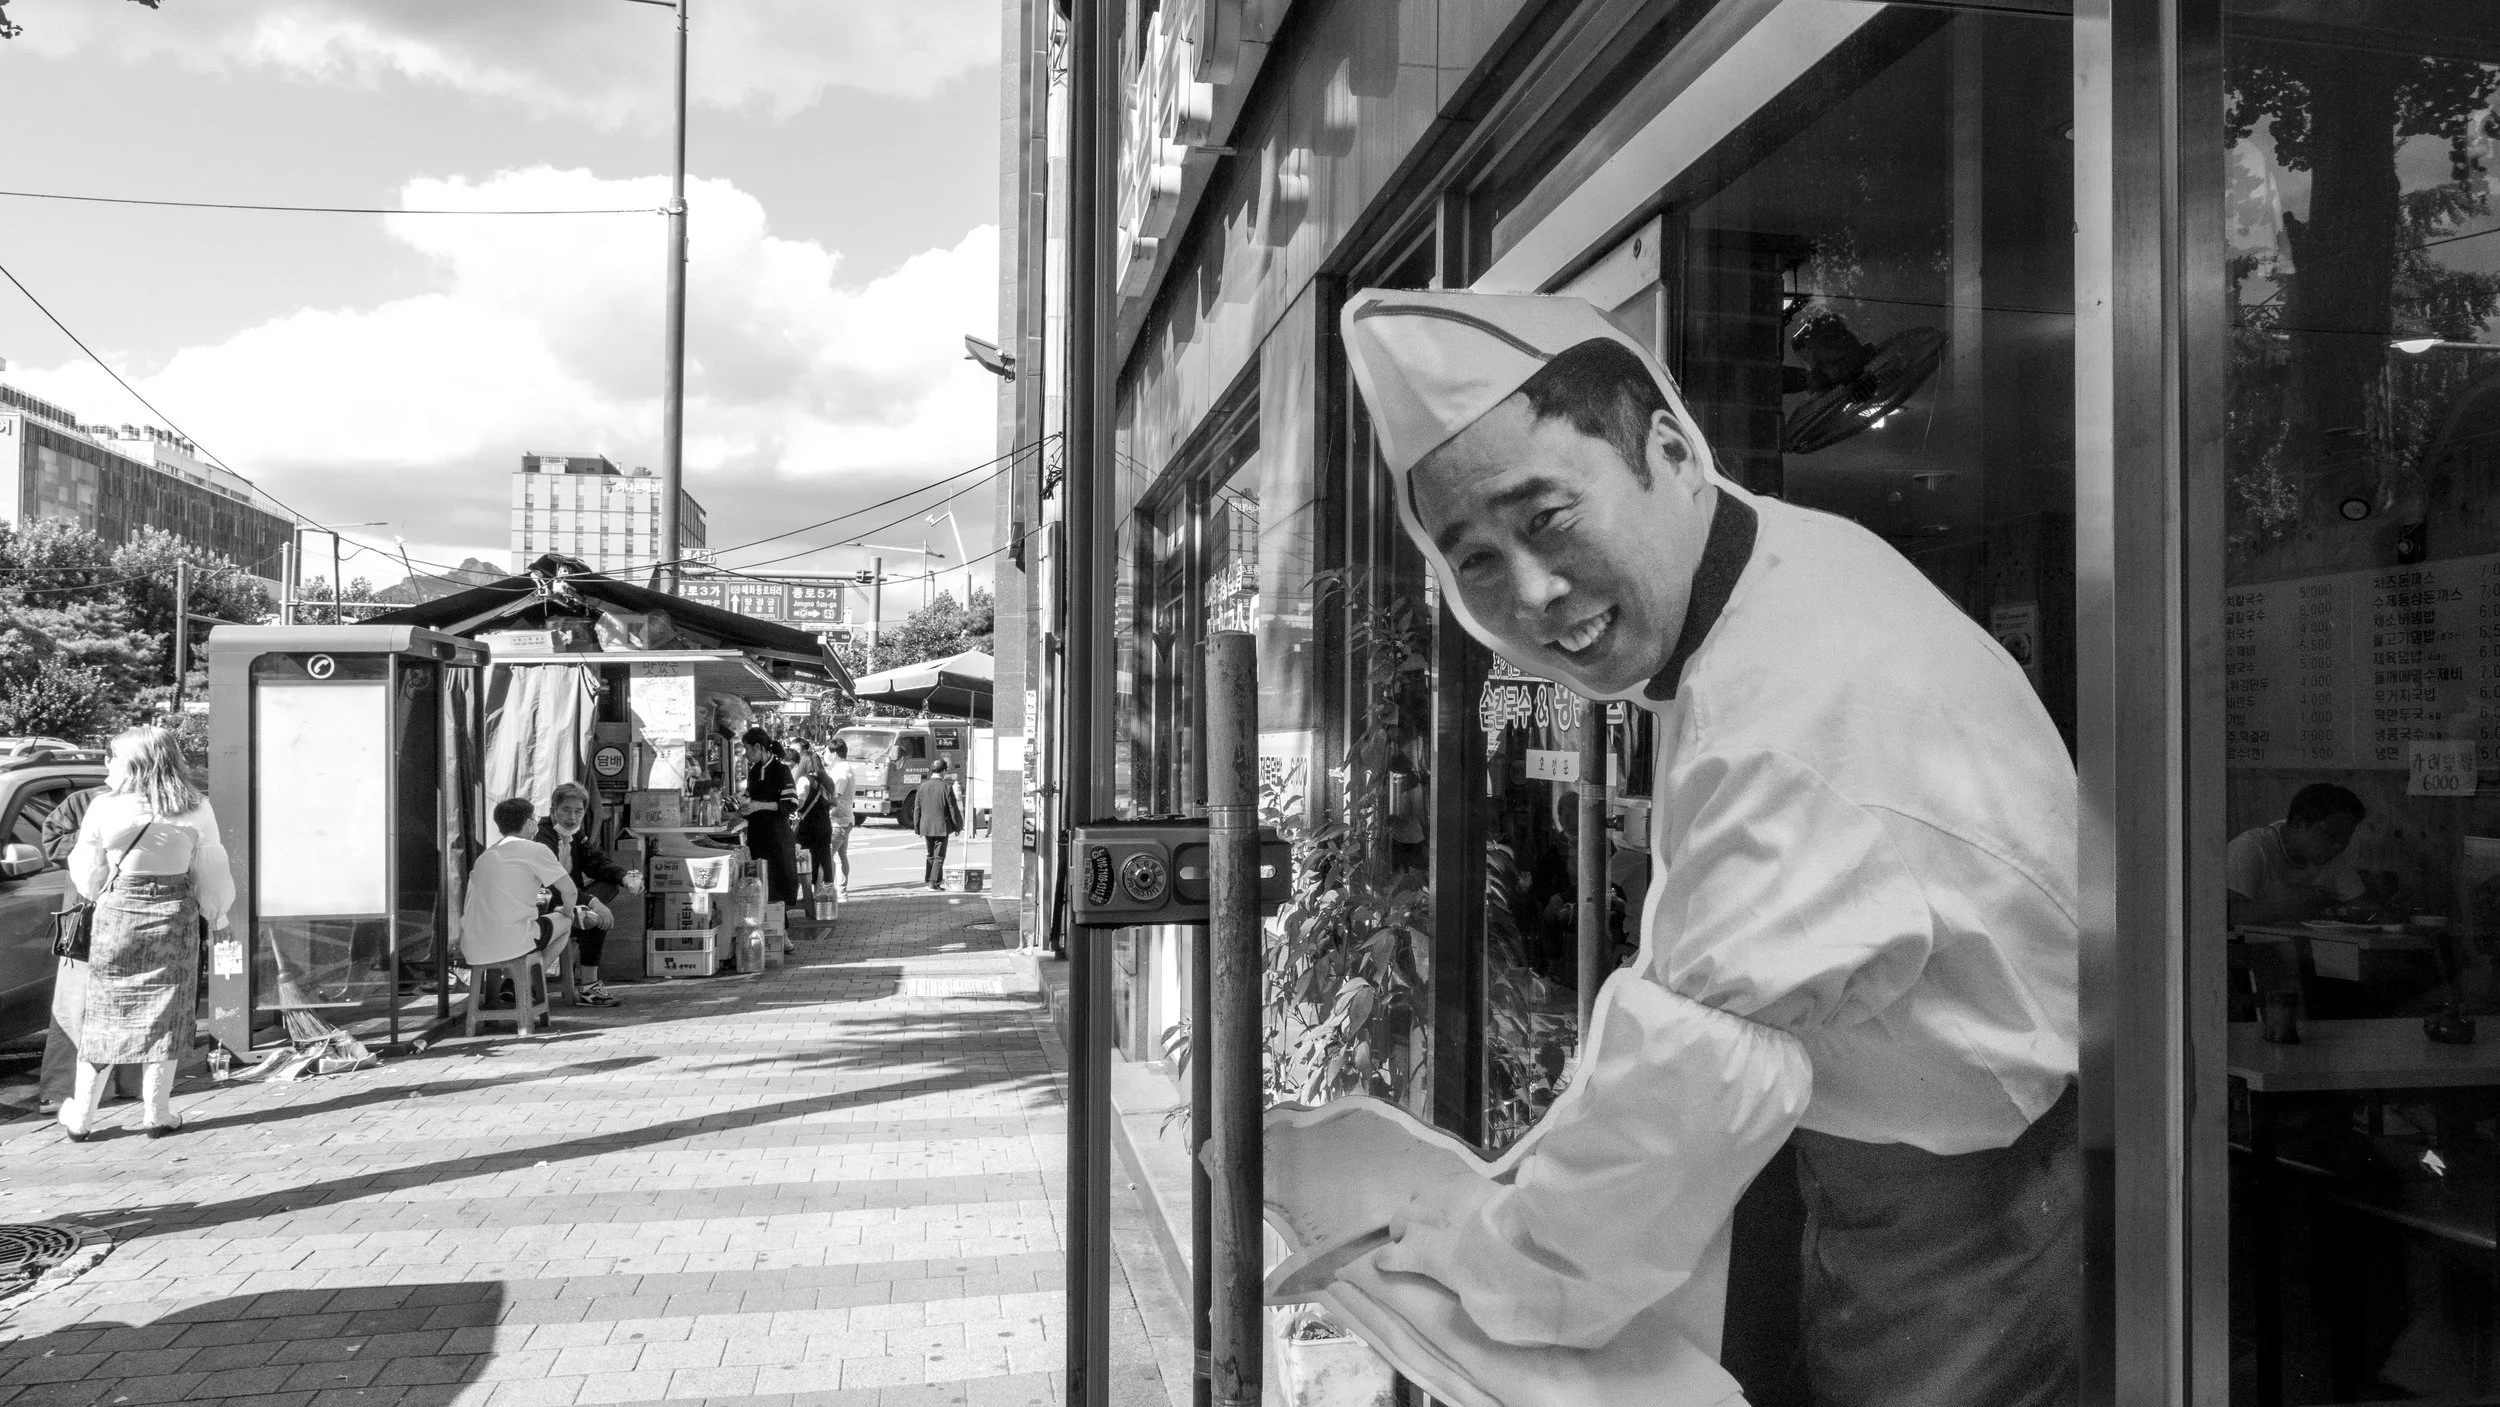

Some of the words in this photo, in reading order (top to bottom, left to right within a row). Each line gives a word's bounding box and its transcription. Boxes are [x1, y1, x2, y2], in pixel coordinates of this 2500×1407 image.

[680, 550, 714, 561] 로4가
[2374, 572, 2436, 589] 치즈돈까스
[792, 587, 837, 599] 종로5가
[2374, 588, 2462, 609] 수제등심돈까스
[1479, 681, 1532, 732] 손칼국수
[1535, 684, 1549, 728] &
[597, 756, 622, 767] 담배
[2423, 775, 2459, 791] 6000
